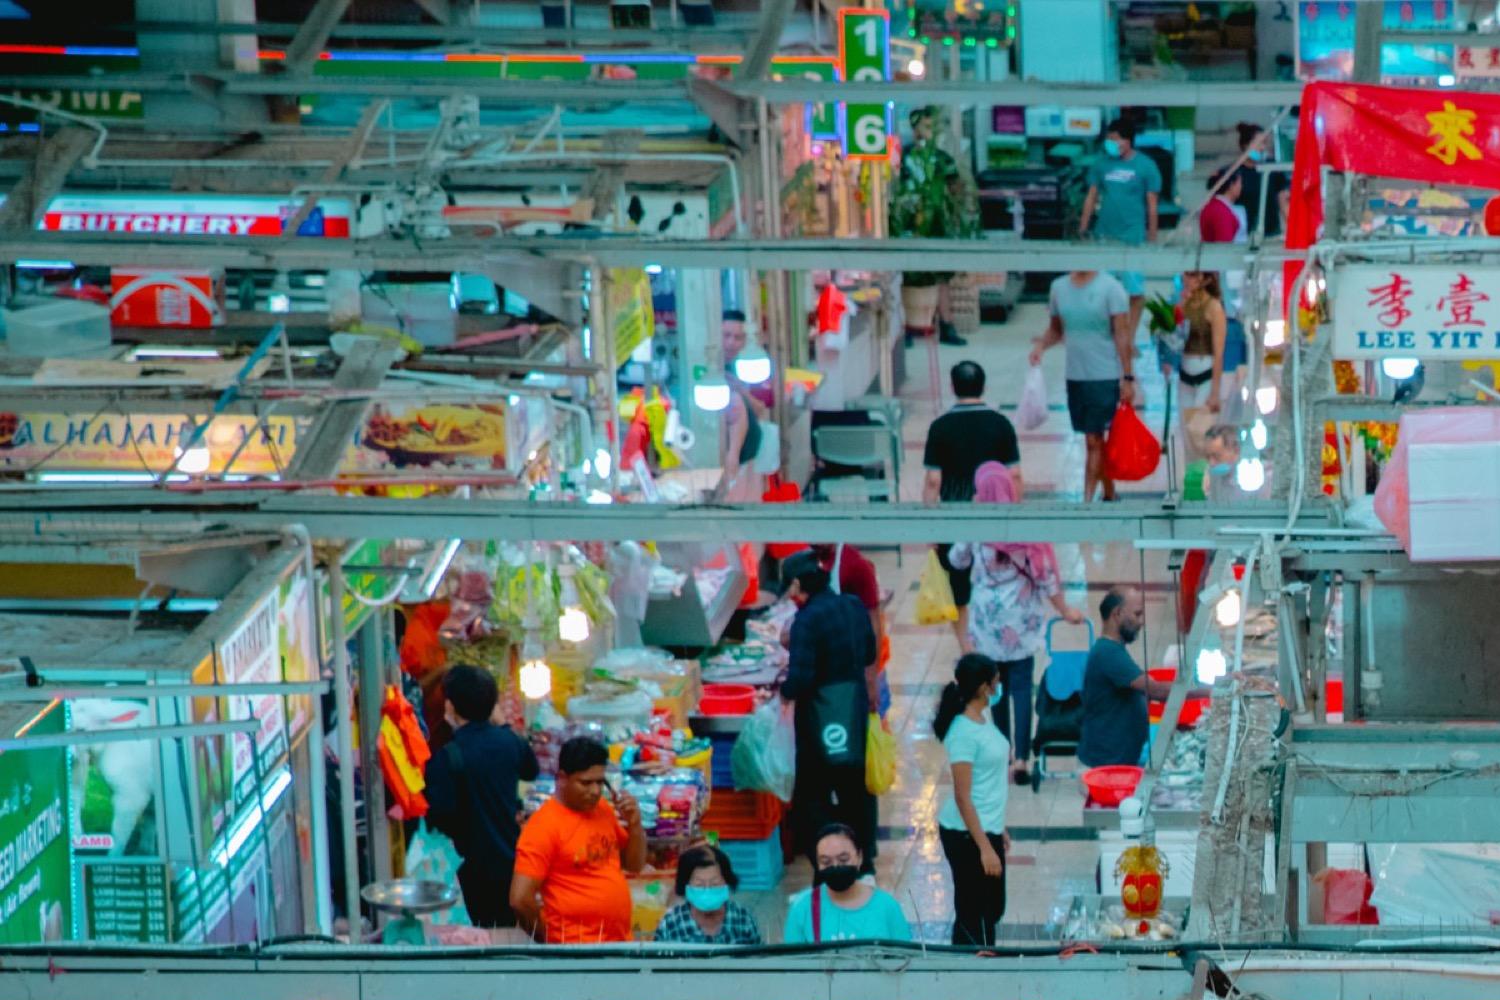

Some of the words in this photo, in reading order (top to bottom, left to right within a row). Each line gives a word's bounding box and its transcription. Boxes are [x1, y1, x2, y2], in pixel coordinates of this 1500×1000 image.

[854, 19, 877, 56] 1
[60, 214, 257, 235] BUTCHERY
[1357, 331, 1416, 349] LEE
[1428, 331, 1483, 349] YIT
[73, 836, 112, 848] LAMB
